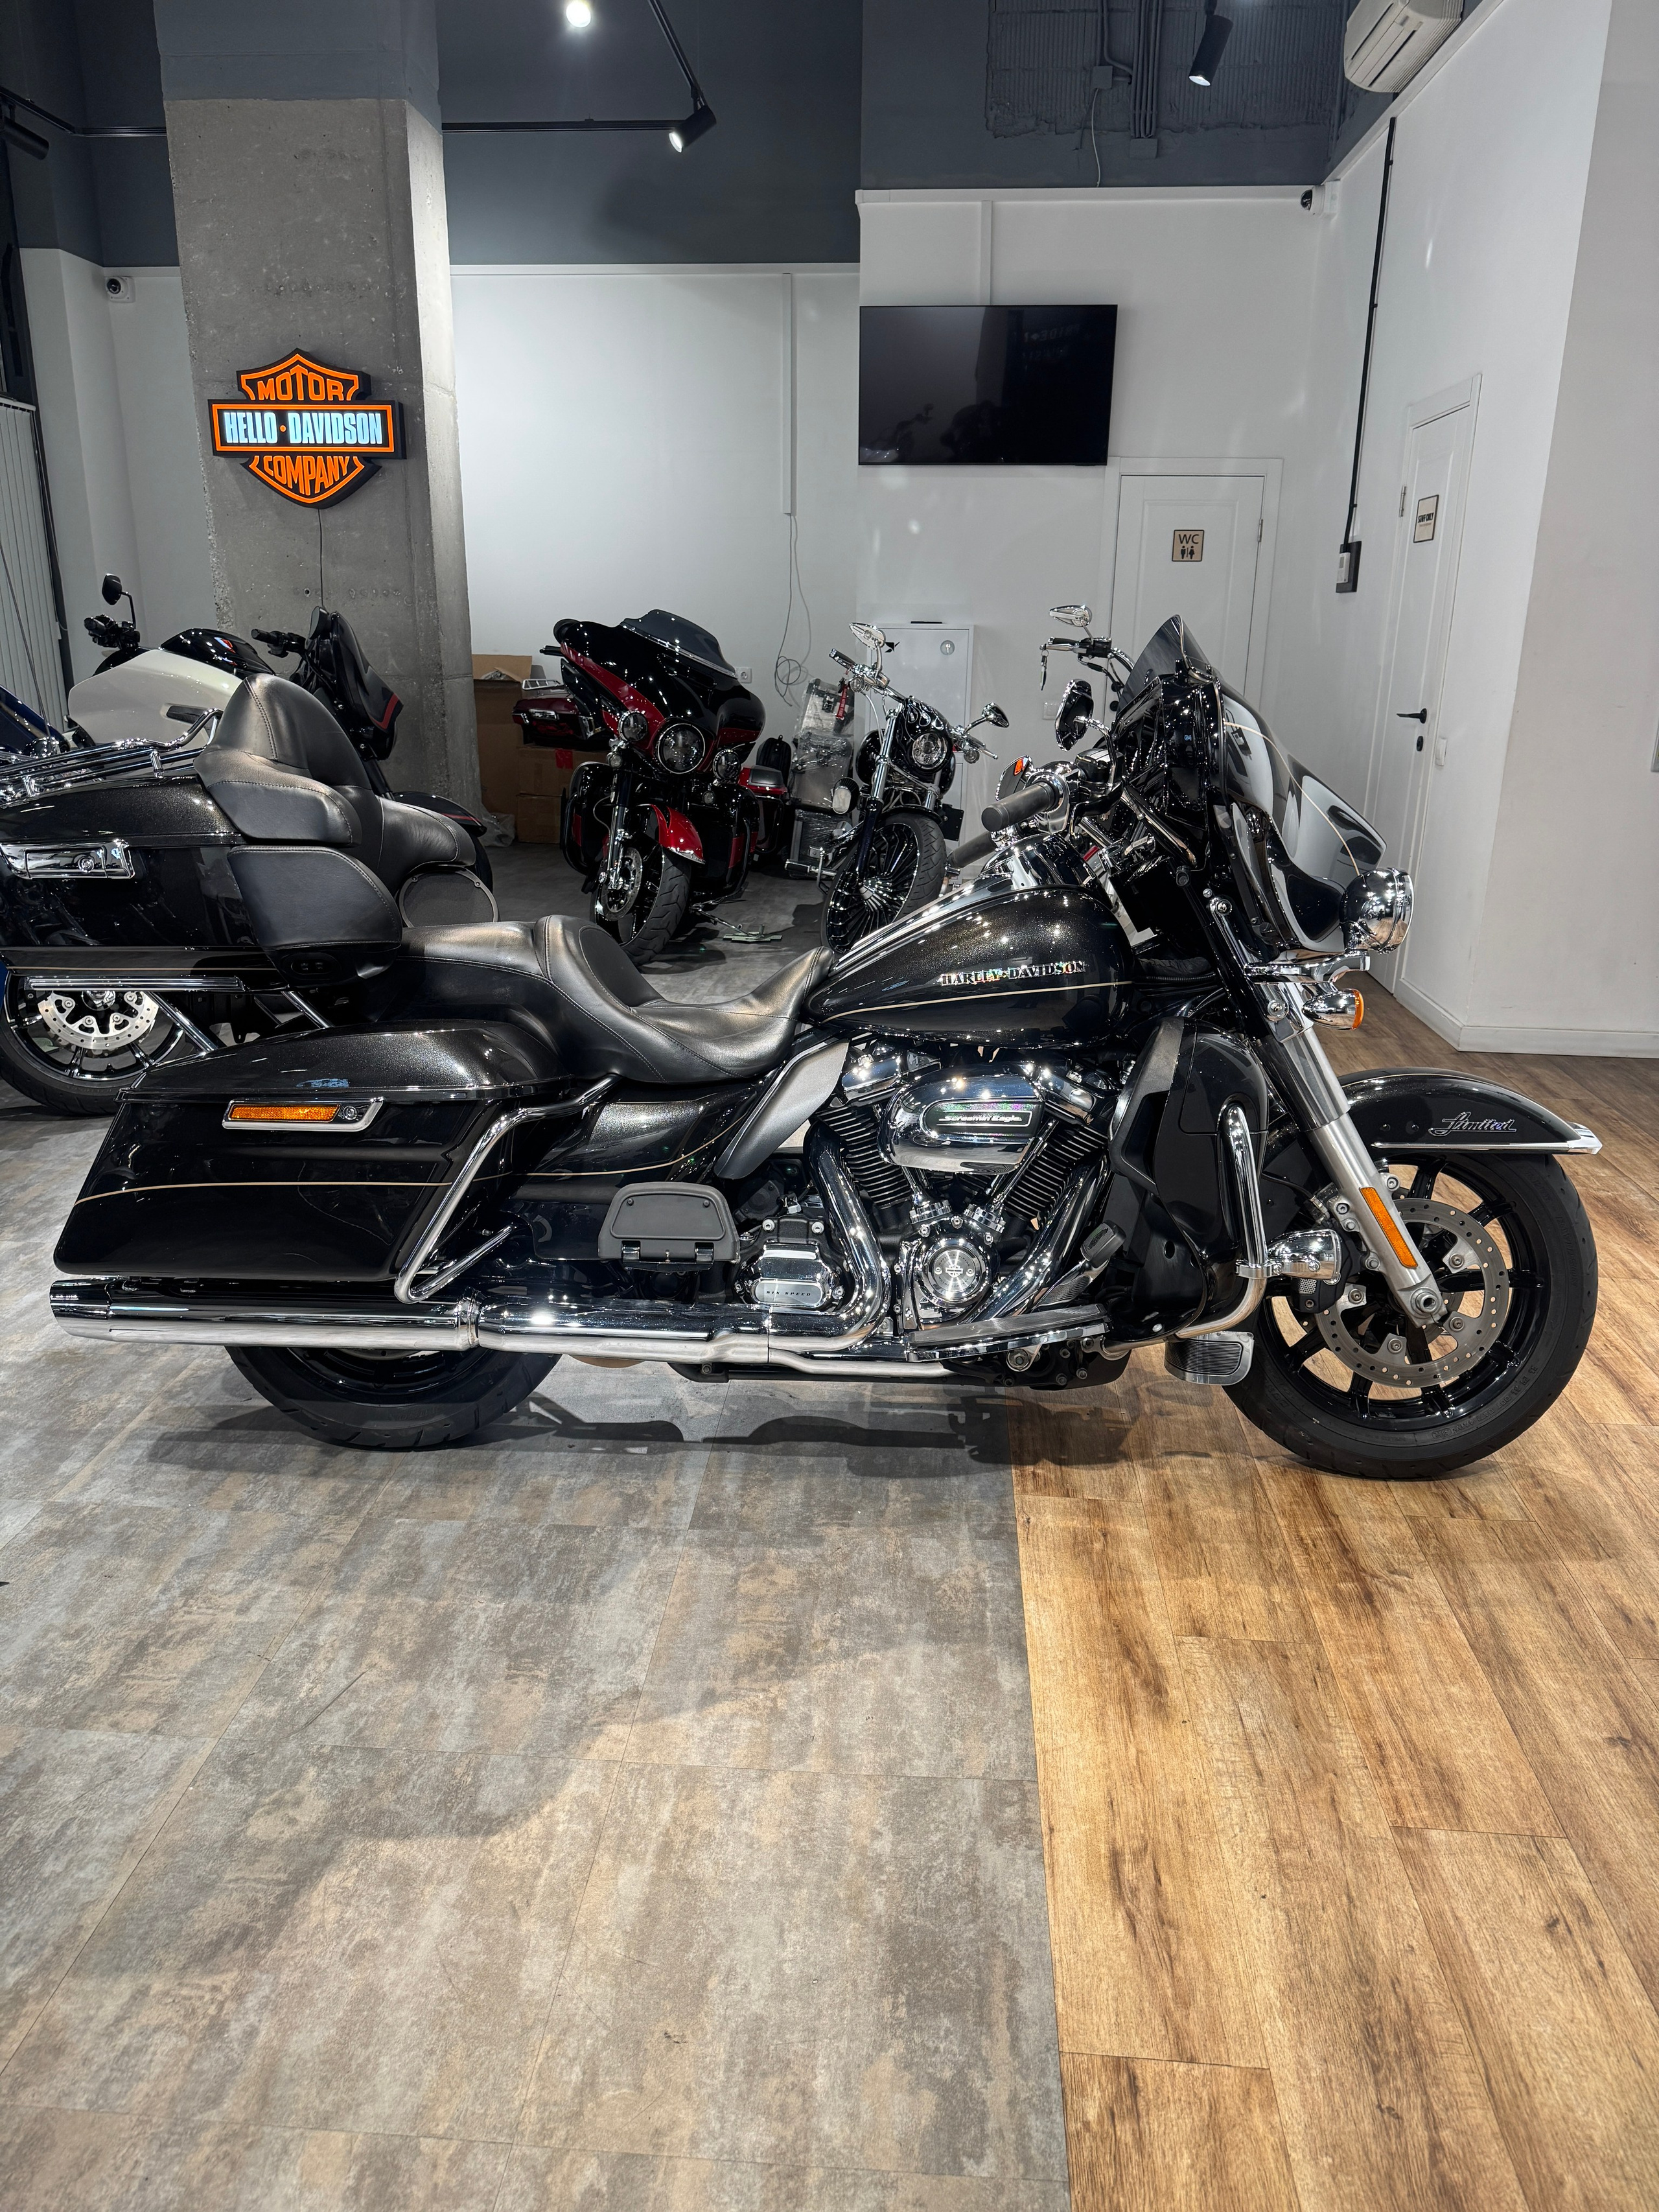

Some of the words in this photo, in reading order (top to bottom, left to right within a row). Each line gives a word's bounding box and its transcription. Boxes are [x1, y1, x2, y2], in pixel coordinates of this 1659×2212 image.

[257, 364, 343, 401] MOTOR
[224, 412, 278, 443] HELLO
[288, 412, 383, 445] DAVIDSON
[263, 455, 350, 496] COMPANY
[1178, 533, 1200, 544] WC
[940, 968, 1002, 986] HARLEY
[1008, 960, 1088, 979] DAVIDSON
[1428, 1112, 1517, 1136] Limited
